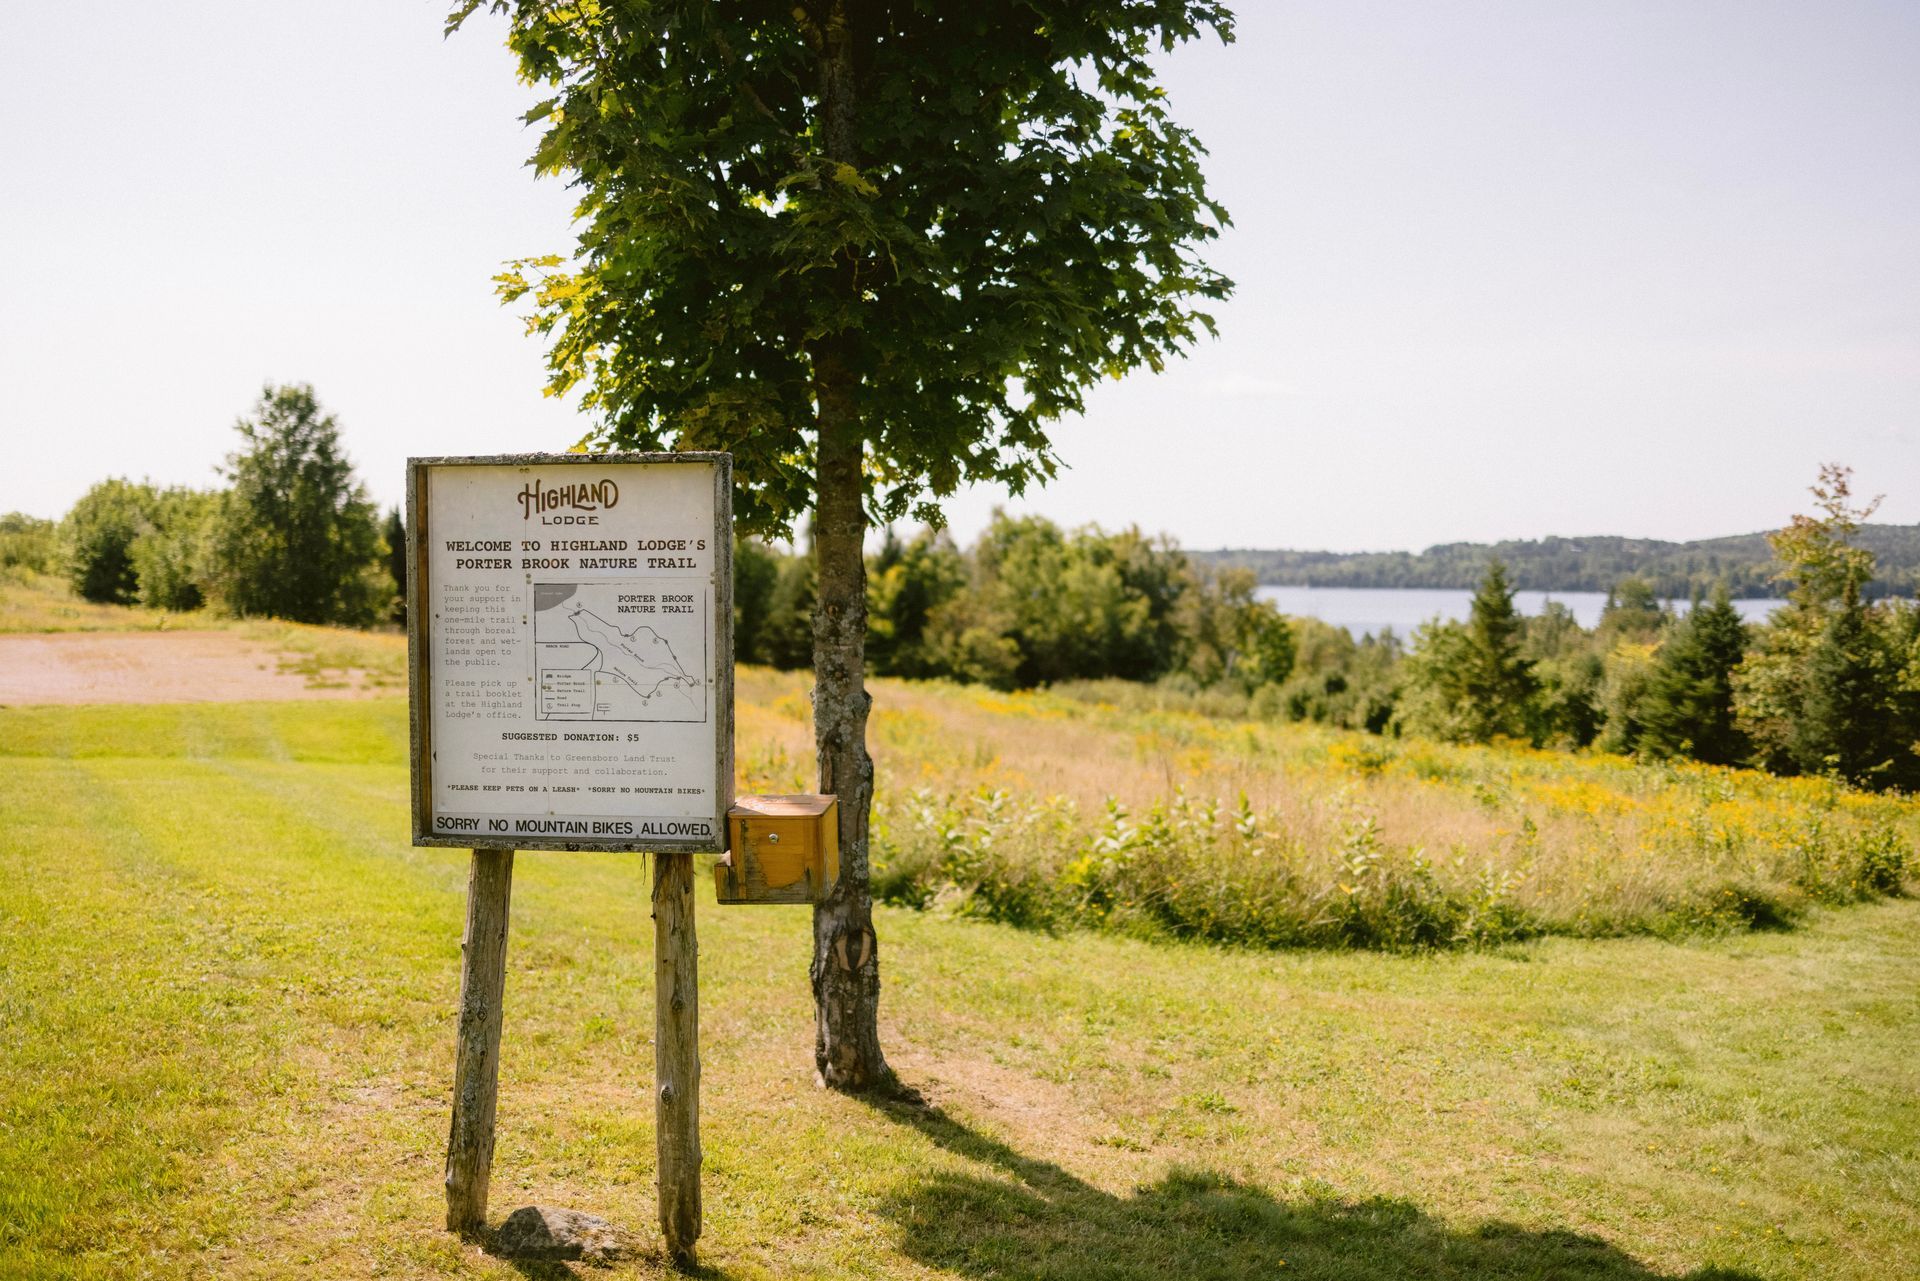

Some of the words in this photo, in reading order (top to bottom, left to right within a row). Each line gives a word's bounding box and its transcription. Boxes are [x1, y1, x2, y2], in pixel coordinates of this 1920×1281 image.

[518, 479, 618, 520] HIGHLAND
[542, 516, 599, 525] LODGE
[446, 541, 511, 551] WELCOME
[522, 541, 540, 551] TO
[551, 540, 628, 551] HIGHLAND
[638, 540, 706, 551] LODGE'S
[456, 559, 512, 569] PORTER
[522, 559, 569, 569] BROOK
[580, 558, 637, 568] NATURE
[648, 558, 696, 568] TRAIL
[444, 628, 480, 636] through
[481, 701, 522, 709] Highland
[628, 734, 639, 742] $5
[473, 753, 508, 761] Special
[436, 816, 480, 830] SORRY
[489, 819, 508, 831] NO
[516, 820, 588, 833] MOUNTAIN
[593, 822, 633, 834] BIKES
[641, 823, 712, 836] ALLOWED.
